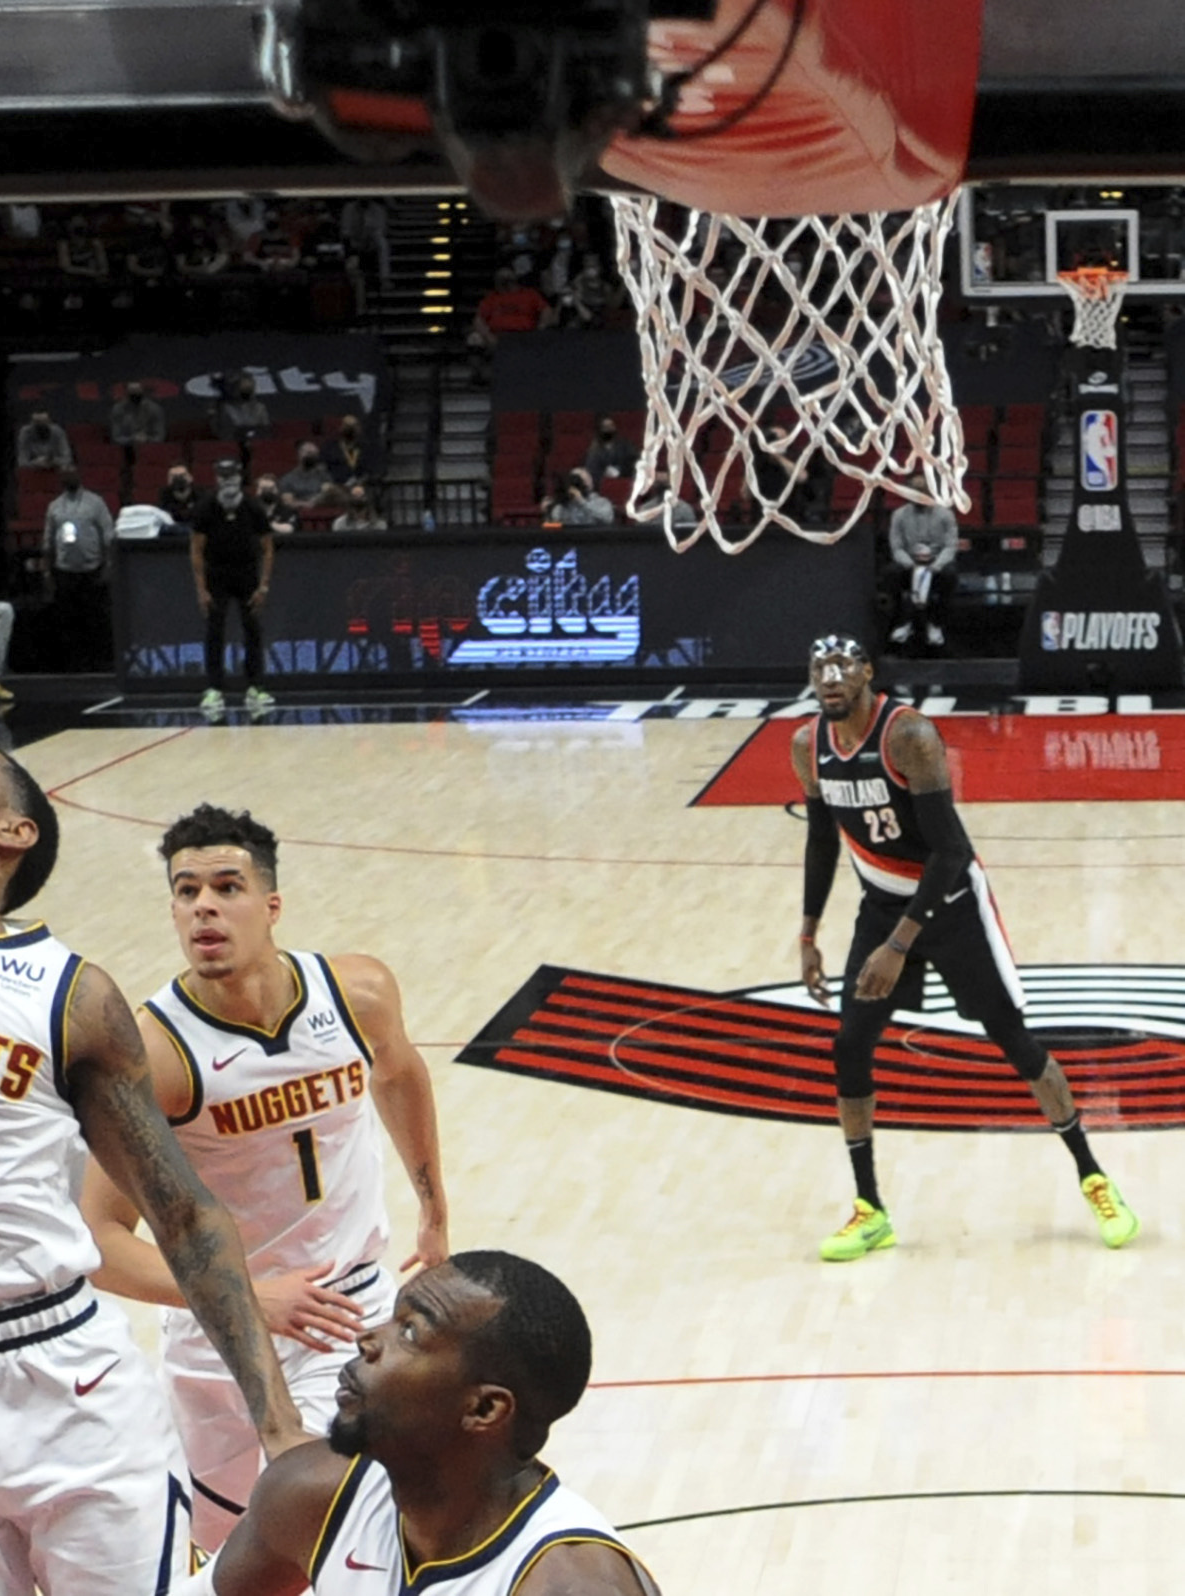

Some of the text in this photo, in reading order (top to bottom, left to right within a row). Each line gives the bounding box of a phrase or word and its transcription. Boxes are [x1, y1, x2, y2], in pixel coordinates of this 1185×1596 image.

[1062, 611, 1160, 650] PLAYOFFS
[863, 807, 902, 843] 23
[1, 955, 46, 982] WU
[307, 1010, 335, 1031] WU
[207, 1058, 366, 1137] NUGGETS
[292, 1128, 322, 1202] 1
